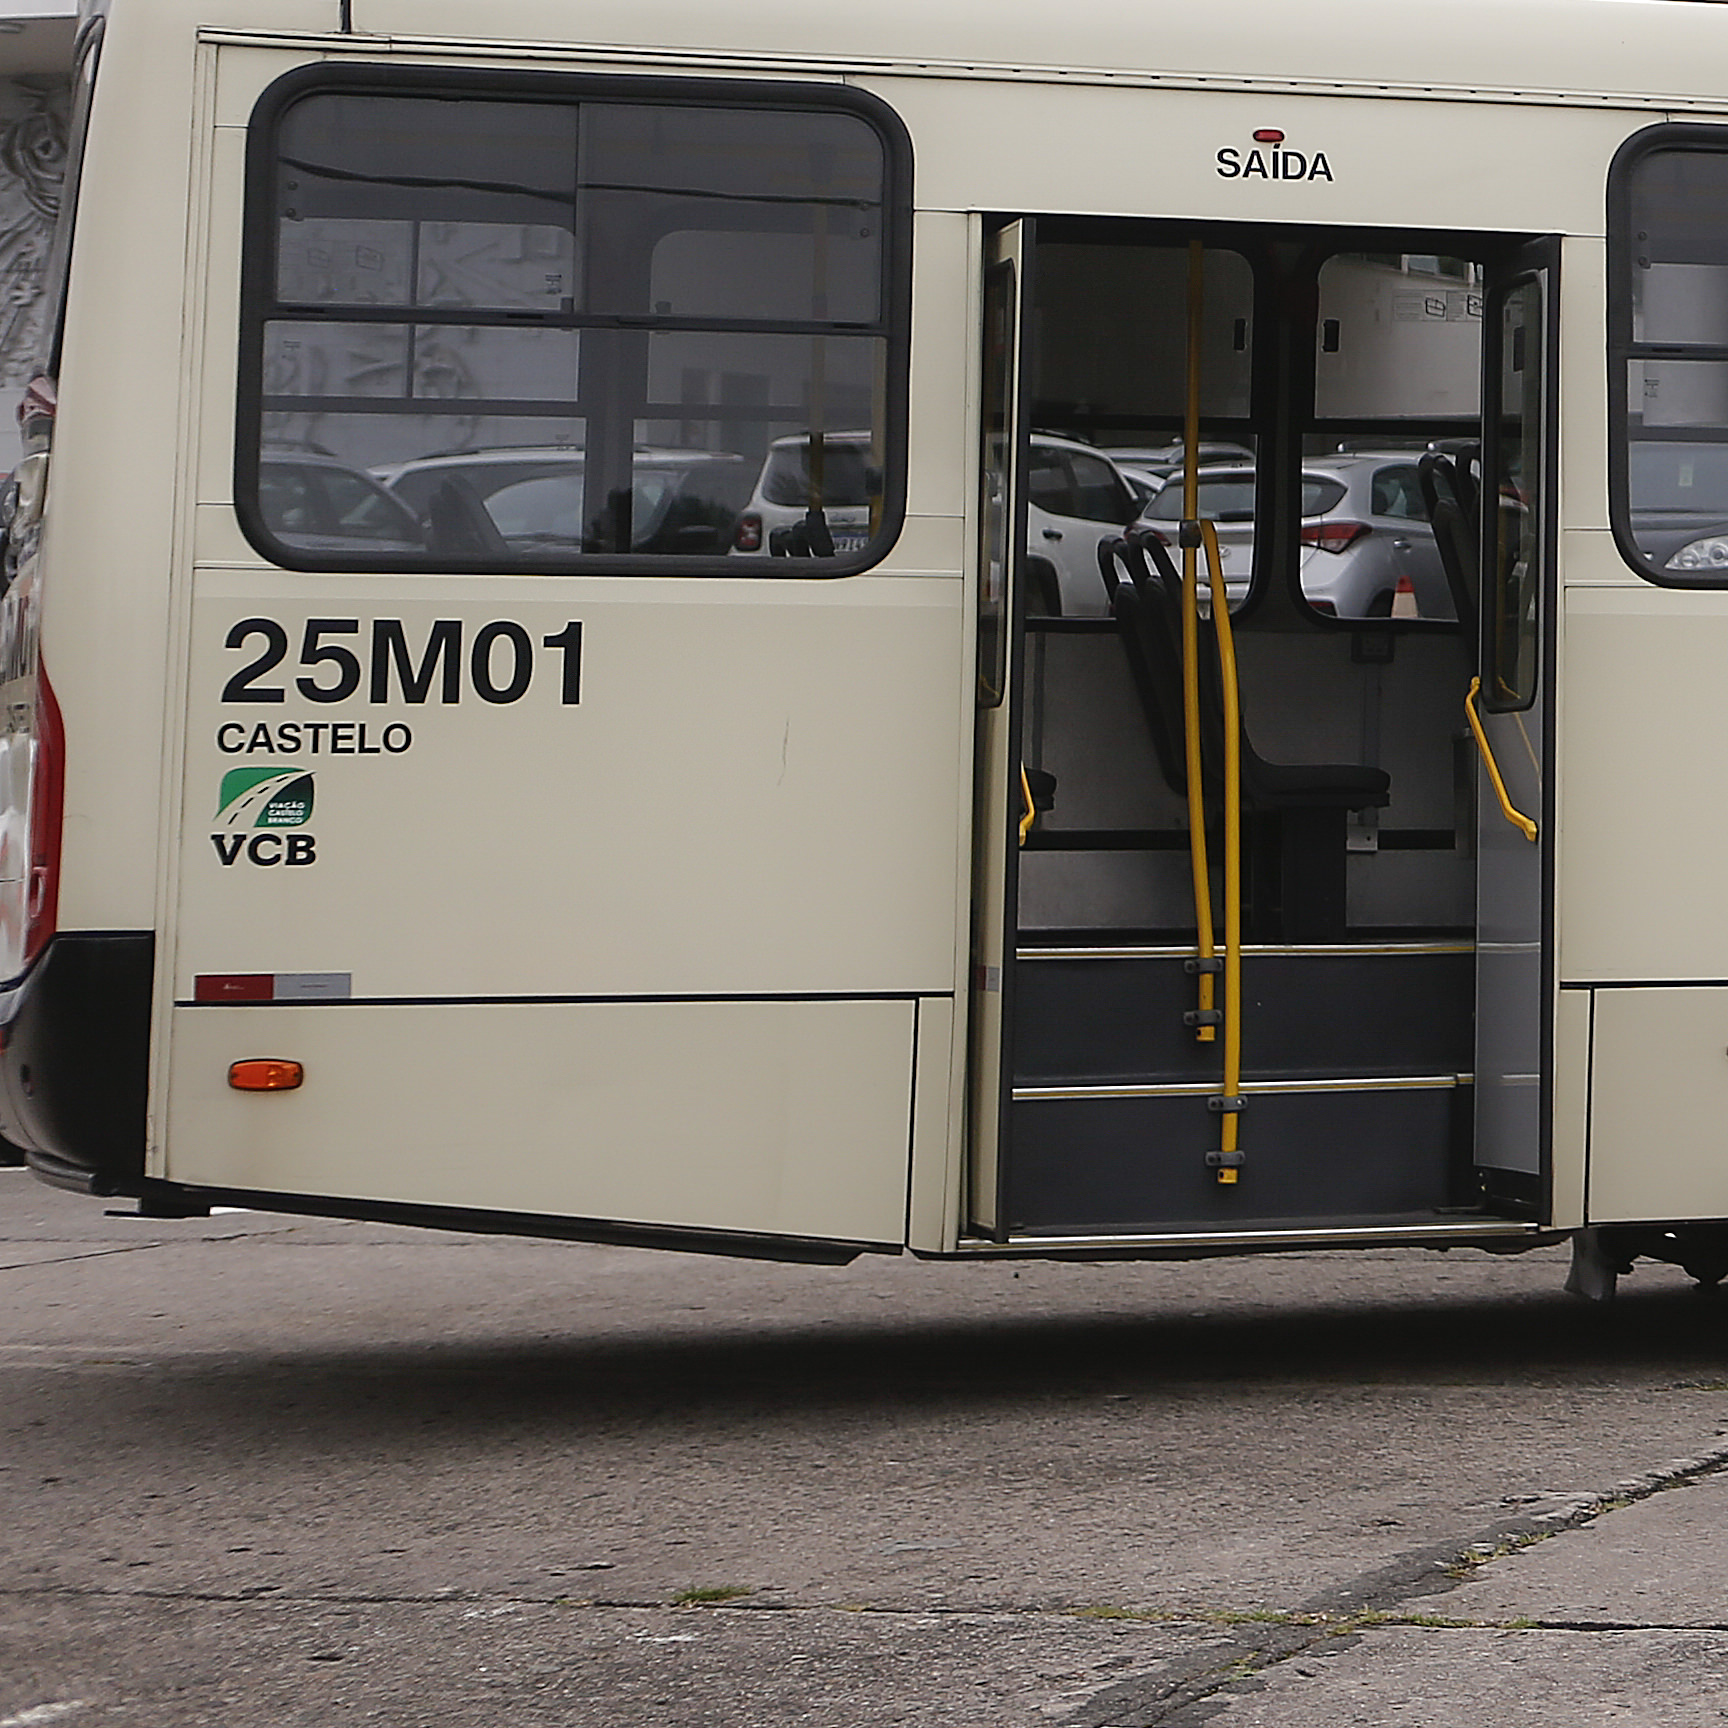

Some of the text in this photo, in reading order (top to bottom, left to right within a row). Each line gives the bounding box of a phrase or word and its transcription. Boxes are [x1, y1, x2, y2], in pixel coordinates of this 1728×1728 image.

[1217, 142, 1333, 182] SAÍDA
[220, 618, 583, 705] 25M01
[217, 722, 412, 754] CASTELO
[210, 833, 317, 867] VCB
